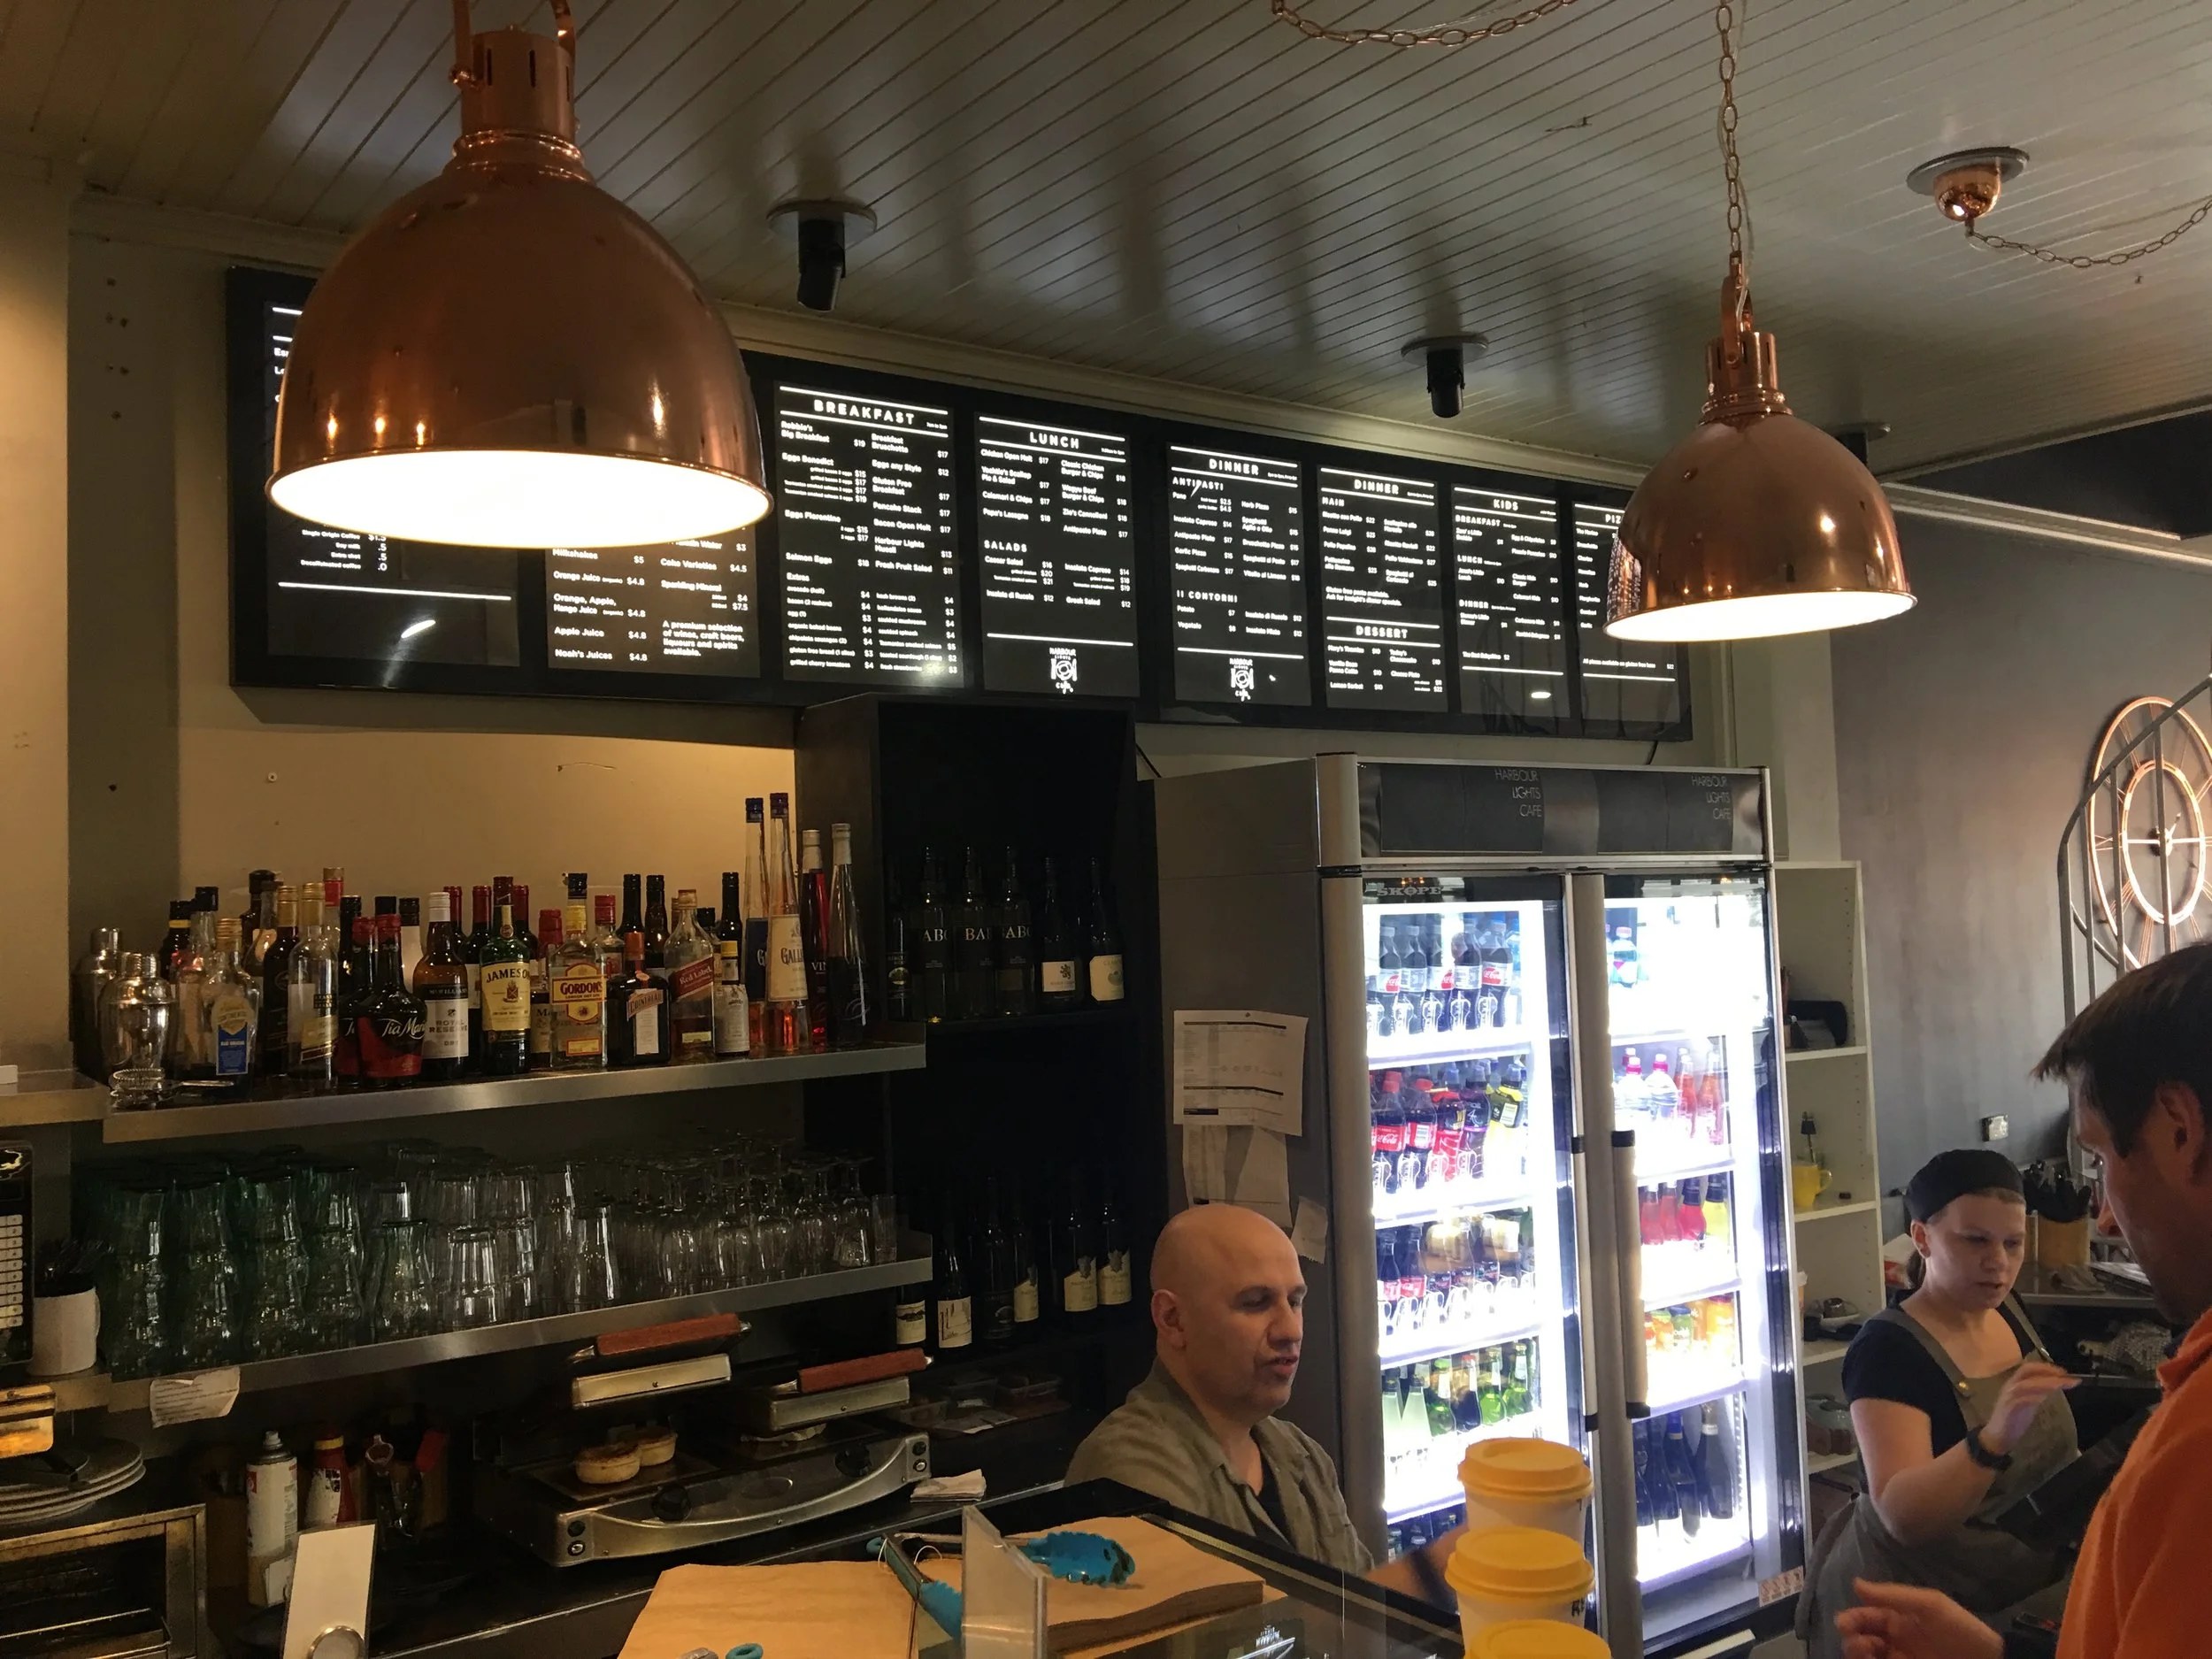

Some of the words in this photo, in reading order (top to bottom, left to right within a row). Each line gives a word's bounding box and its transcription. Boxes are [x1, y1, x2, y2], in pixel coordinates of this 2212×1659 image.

[814, 399, 914, 425] BREAKFAST
[1030, 432, 1079, 449] LUNCH
[1210, 458, 1259, 475] DINNER
[1354, 479, 1399, 495] DINNER
[1322, 496, 1345, 507] MAIN
[1494, 499, 1518, 511] KIDS
[1455, 514, 1501, 526] BREAKFAST
[1605, 514, 1622, 525] PIZ
[984, 540, 1027, 553] SALADS
[1457, 555, 1483, 565] LUNCH
[1188, 591, 1238, 603] CONTORNI
[1459, 599, 1489, 609] DINNER
[1356, 625, 1408, 639] DESSERT
[1494, 768, 1539, 782] HARBOUR
[1692, 775, 1728, 788] HARBOUR
[1512, 787, 1542, 800] LIGHTS
[1706, 792, 1732, 804] LIGHTS
[1519, 804, 1543, 818] CAFE
[1713, 808, 1732, 821] CAFE
[1377, 885, 1442, 897] SKOPE
